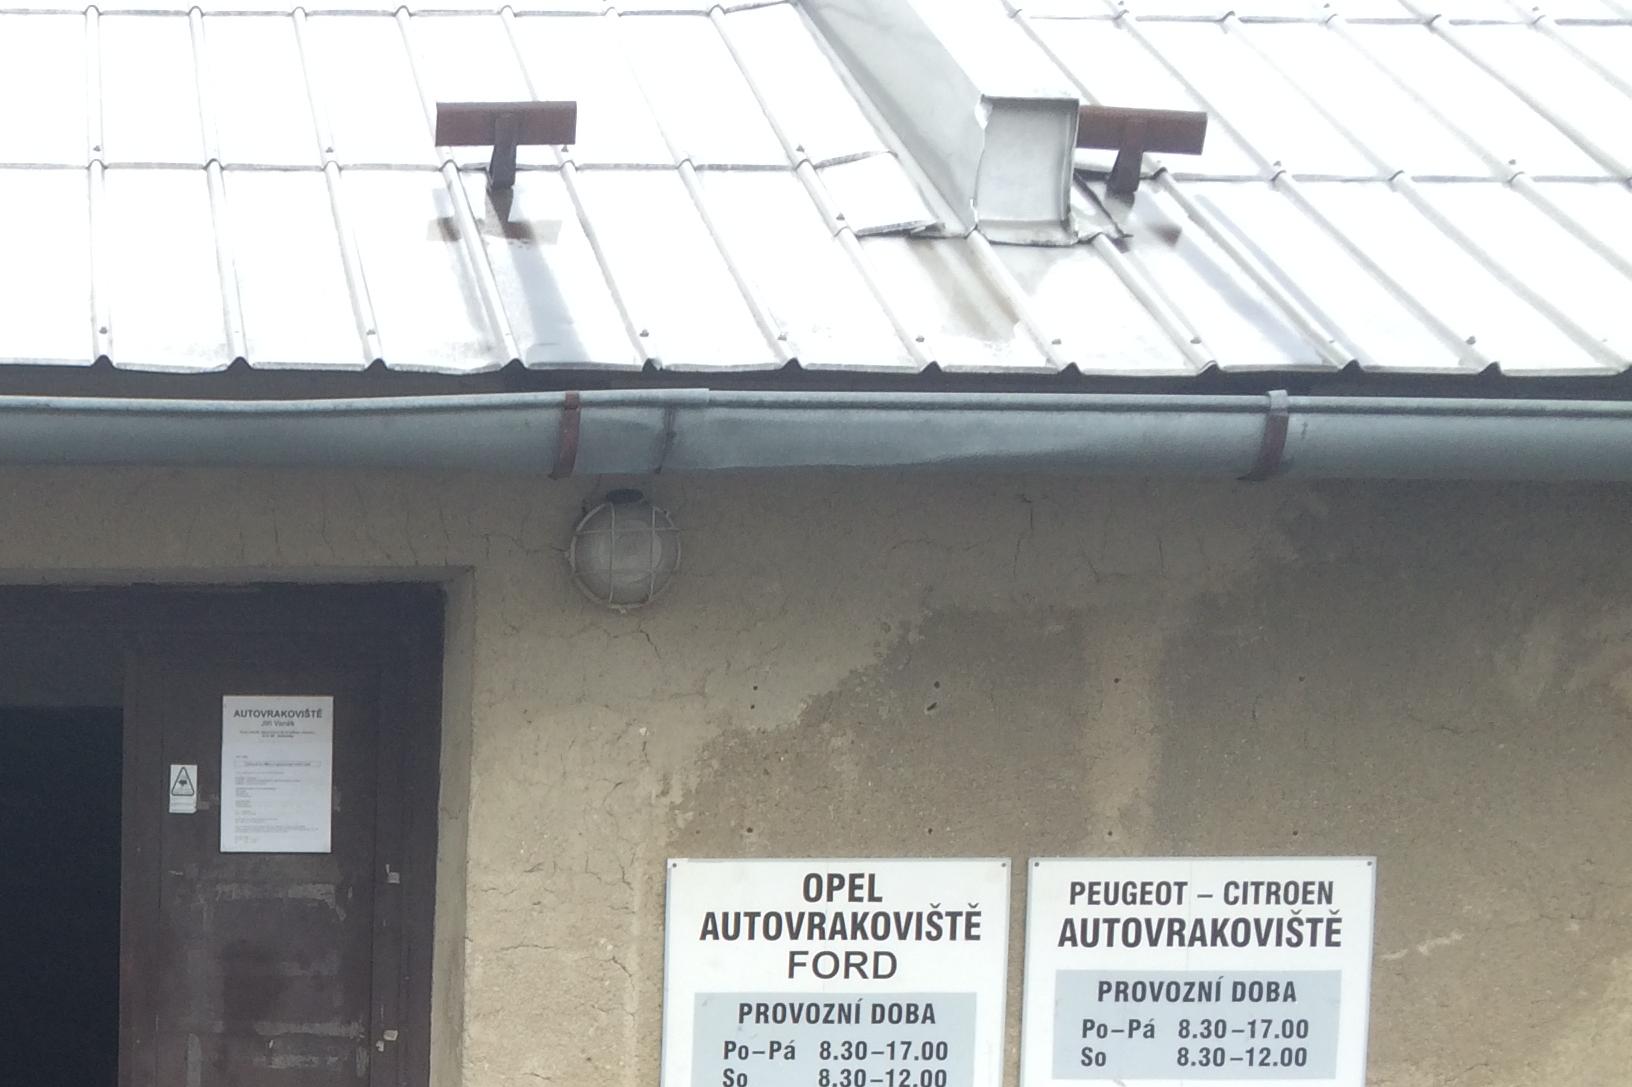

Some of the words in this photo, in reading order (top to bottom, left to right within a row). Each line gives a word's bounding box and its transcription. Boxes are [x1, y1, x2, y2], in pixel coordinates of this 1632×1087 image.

[803, 873, 882, 902] OPEL
[1070, 881, 1188, 905] PEUGEOT
[1224, 881, 1333, 905] CITROEN
[700, 904, 981, 941] AUTOVRAKOVIŠTĚ
[1058, 910, 1342, 947] AUTOVRAKOVIŠTĚ
[789, 951, 897, 979] FORD
[1098, 976, 1223, 1002] PROVOZNÍ
[1232, 981, 1296, 1002] DOBA
[739, 999, 862, 1024] PROVOZNÍ
[872, 1003, 935, 1024] DOBA
[1081, 1047, 1106, 1066] So
[723, 1068, 747, 1087] So
